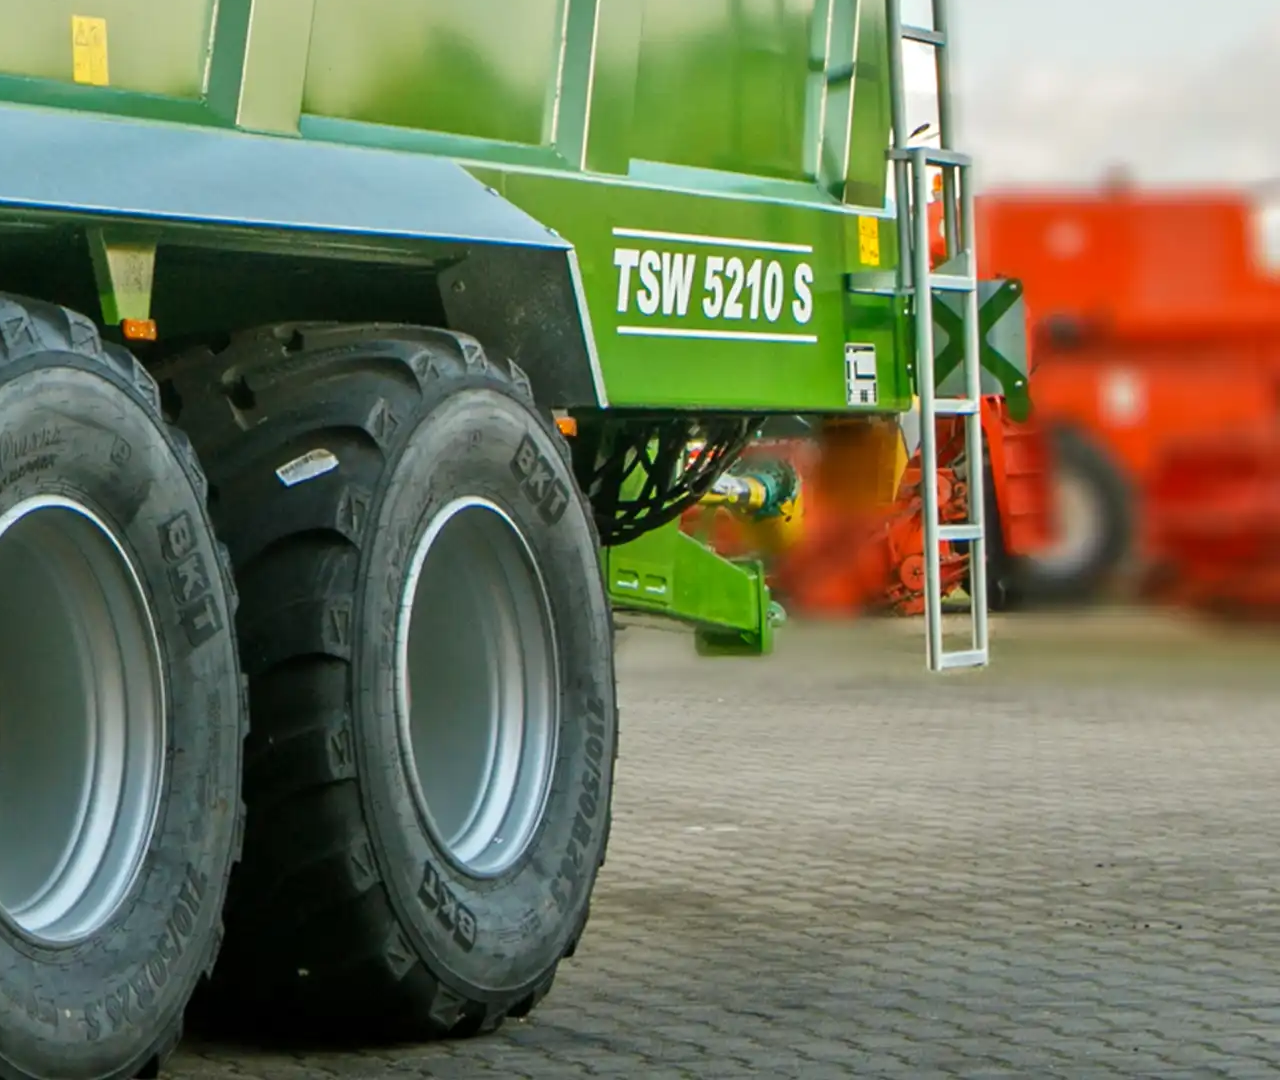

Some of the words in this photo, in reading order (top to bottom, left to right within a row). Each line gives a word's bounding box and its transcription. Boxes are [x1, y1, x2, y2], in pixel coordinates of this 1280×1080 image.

[613, 247, 697, 316] TSW
[702, 255, 784, 322] 5210
[792, 262, 814, 324] S
[511, 434, 570, 526] BKT
[158, 510, 224, 648] BKT
[419, 861, 477, 953] BKT
